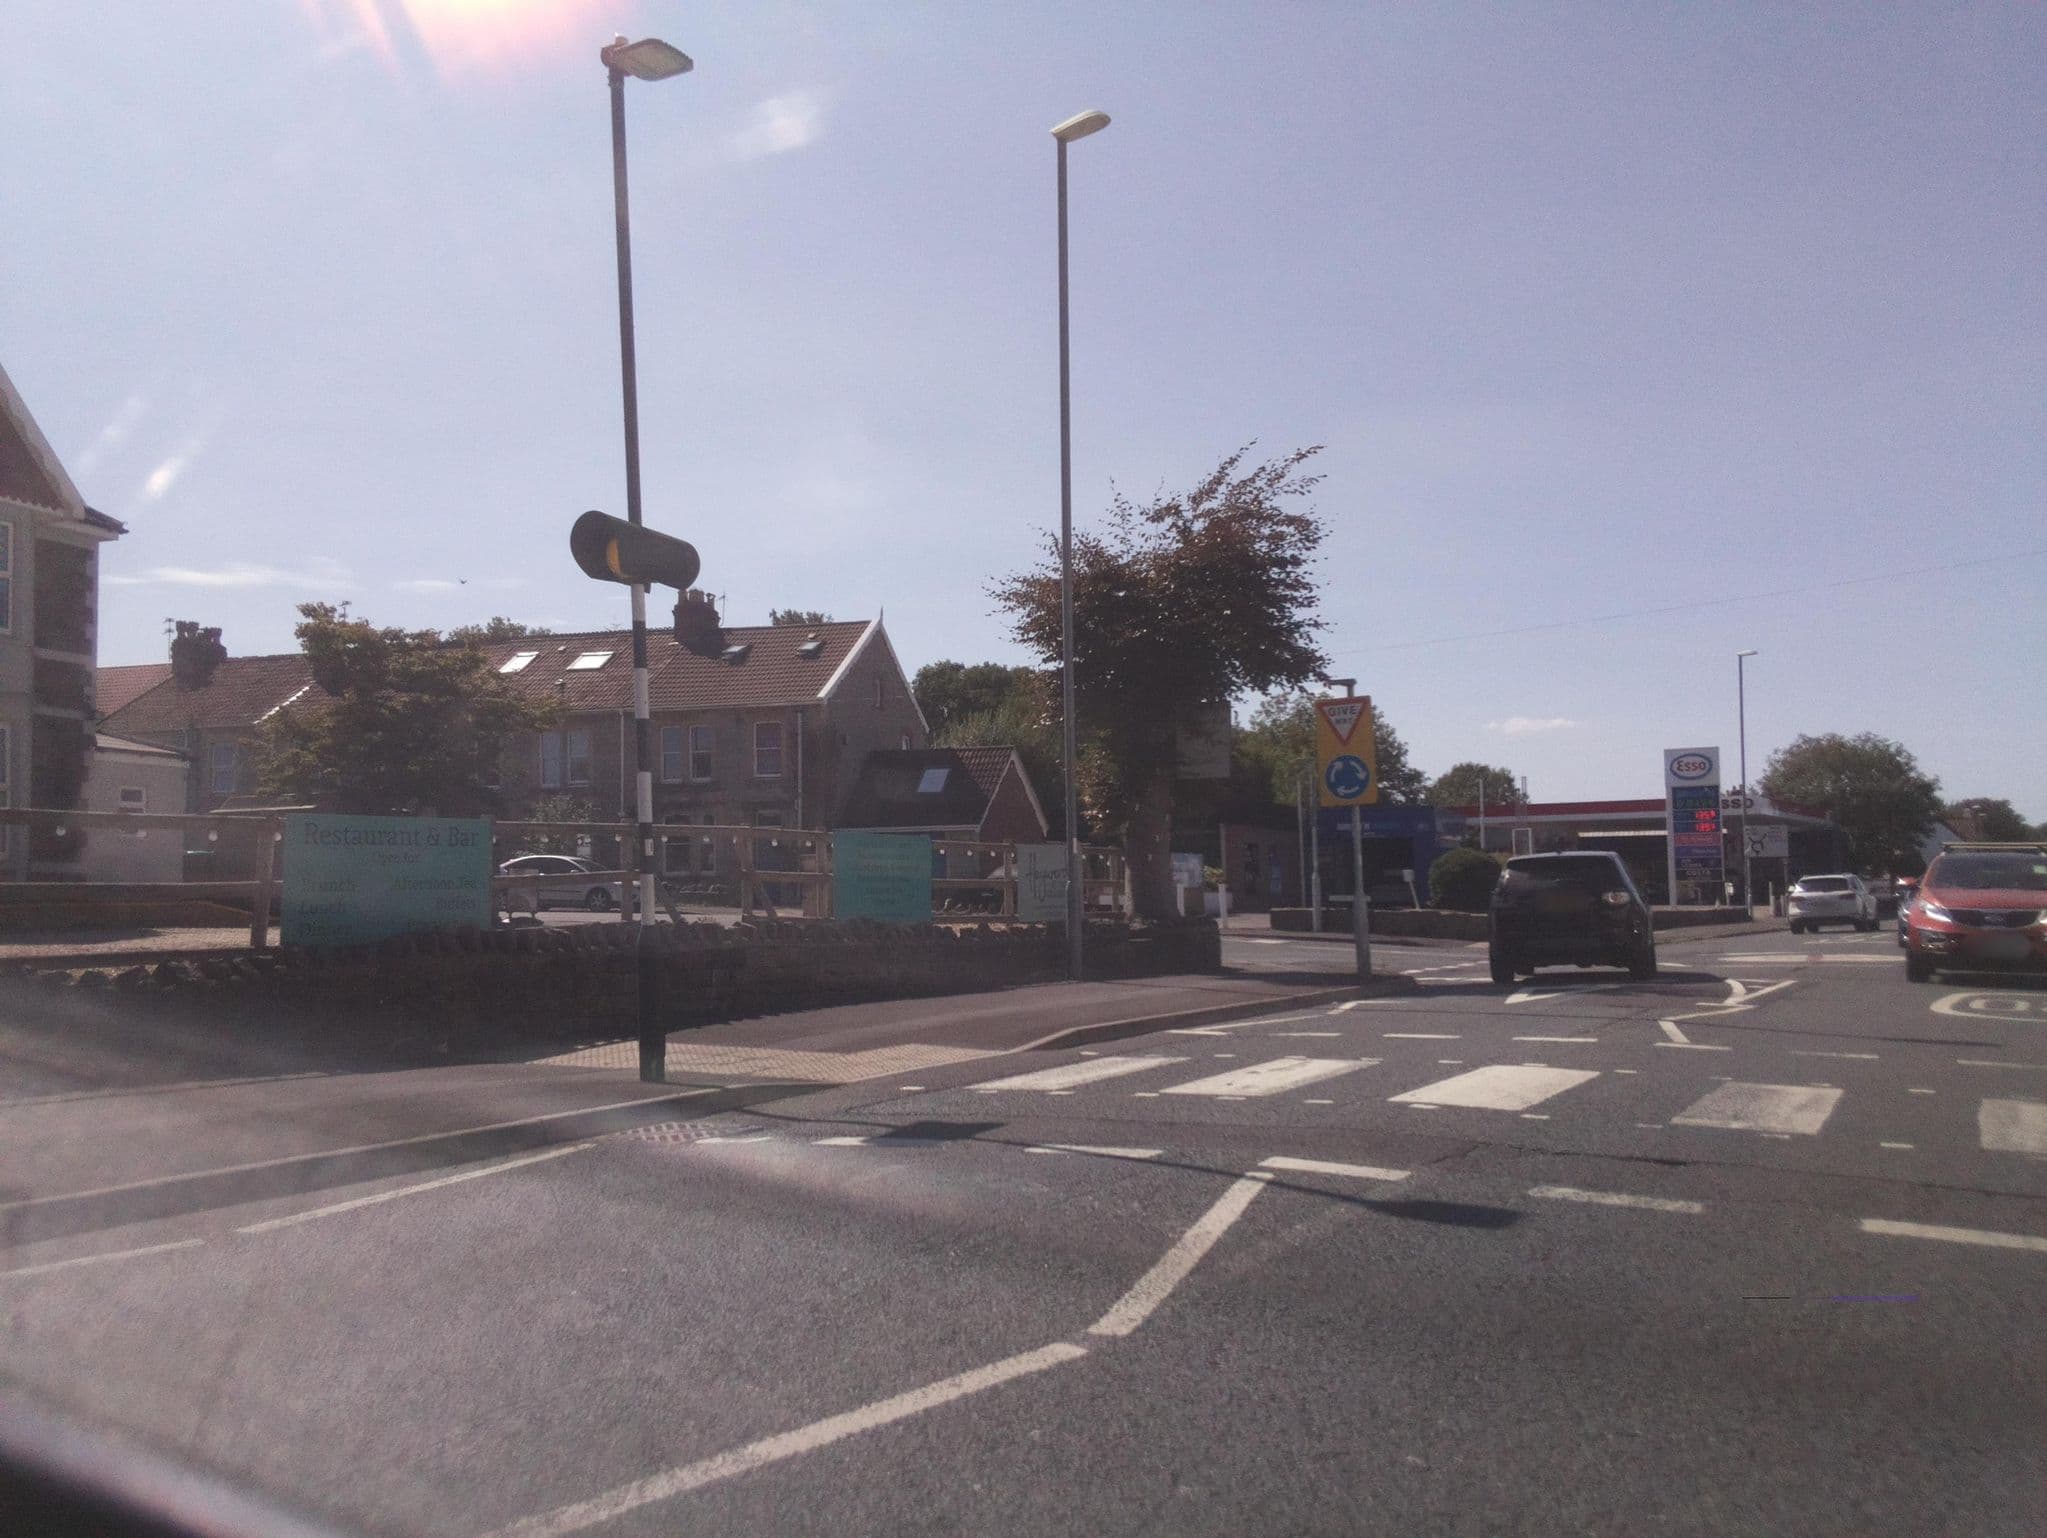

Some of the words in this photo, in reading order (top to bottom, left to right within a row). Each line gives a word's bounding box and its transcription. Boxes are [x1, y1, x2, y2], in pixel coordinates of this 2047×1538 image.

[1328, 704, 1356, 716] GIVE
[1676, 759, 1707, 773] Esso
[304, 821, 421, 846] Restaurant
[426, 827, 441, 846] &
[447, 826, 480, 847] Bar
[403, 852, 421, 864] for
[391, 876, 455, 890] Afternoon
[459, 876, 477, 889] Tea
[299, 901, 347, 915] Lunch
